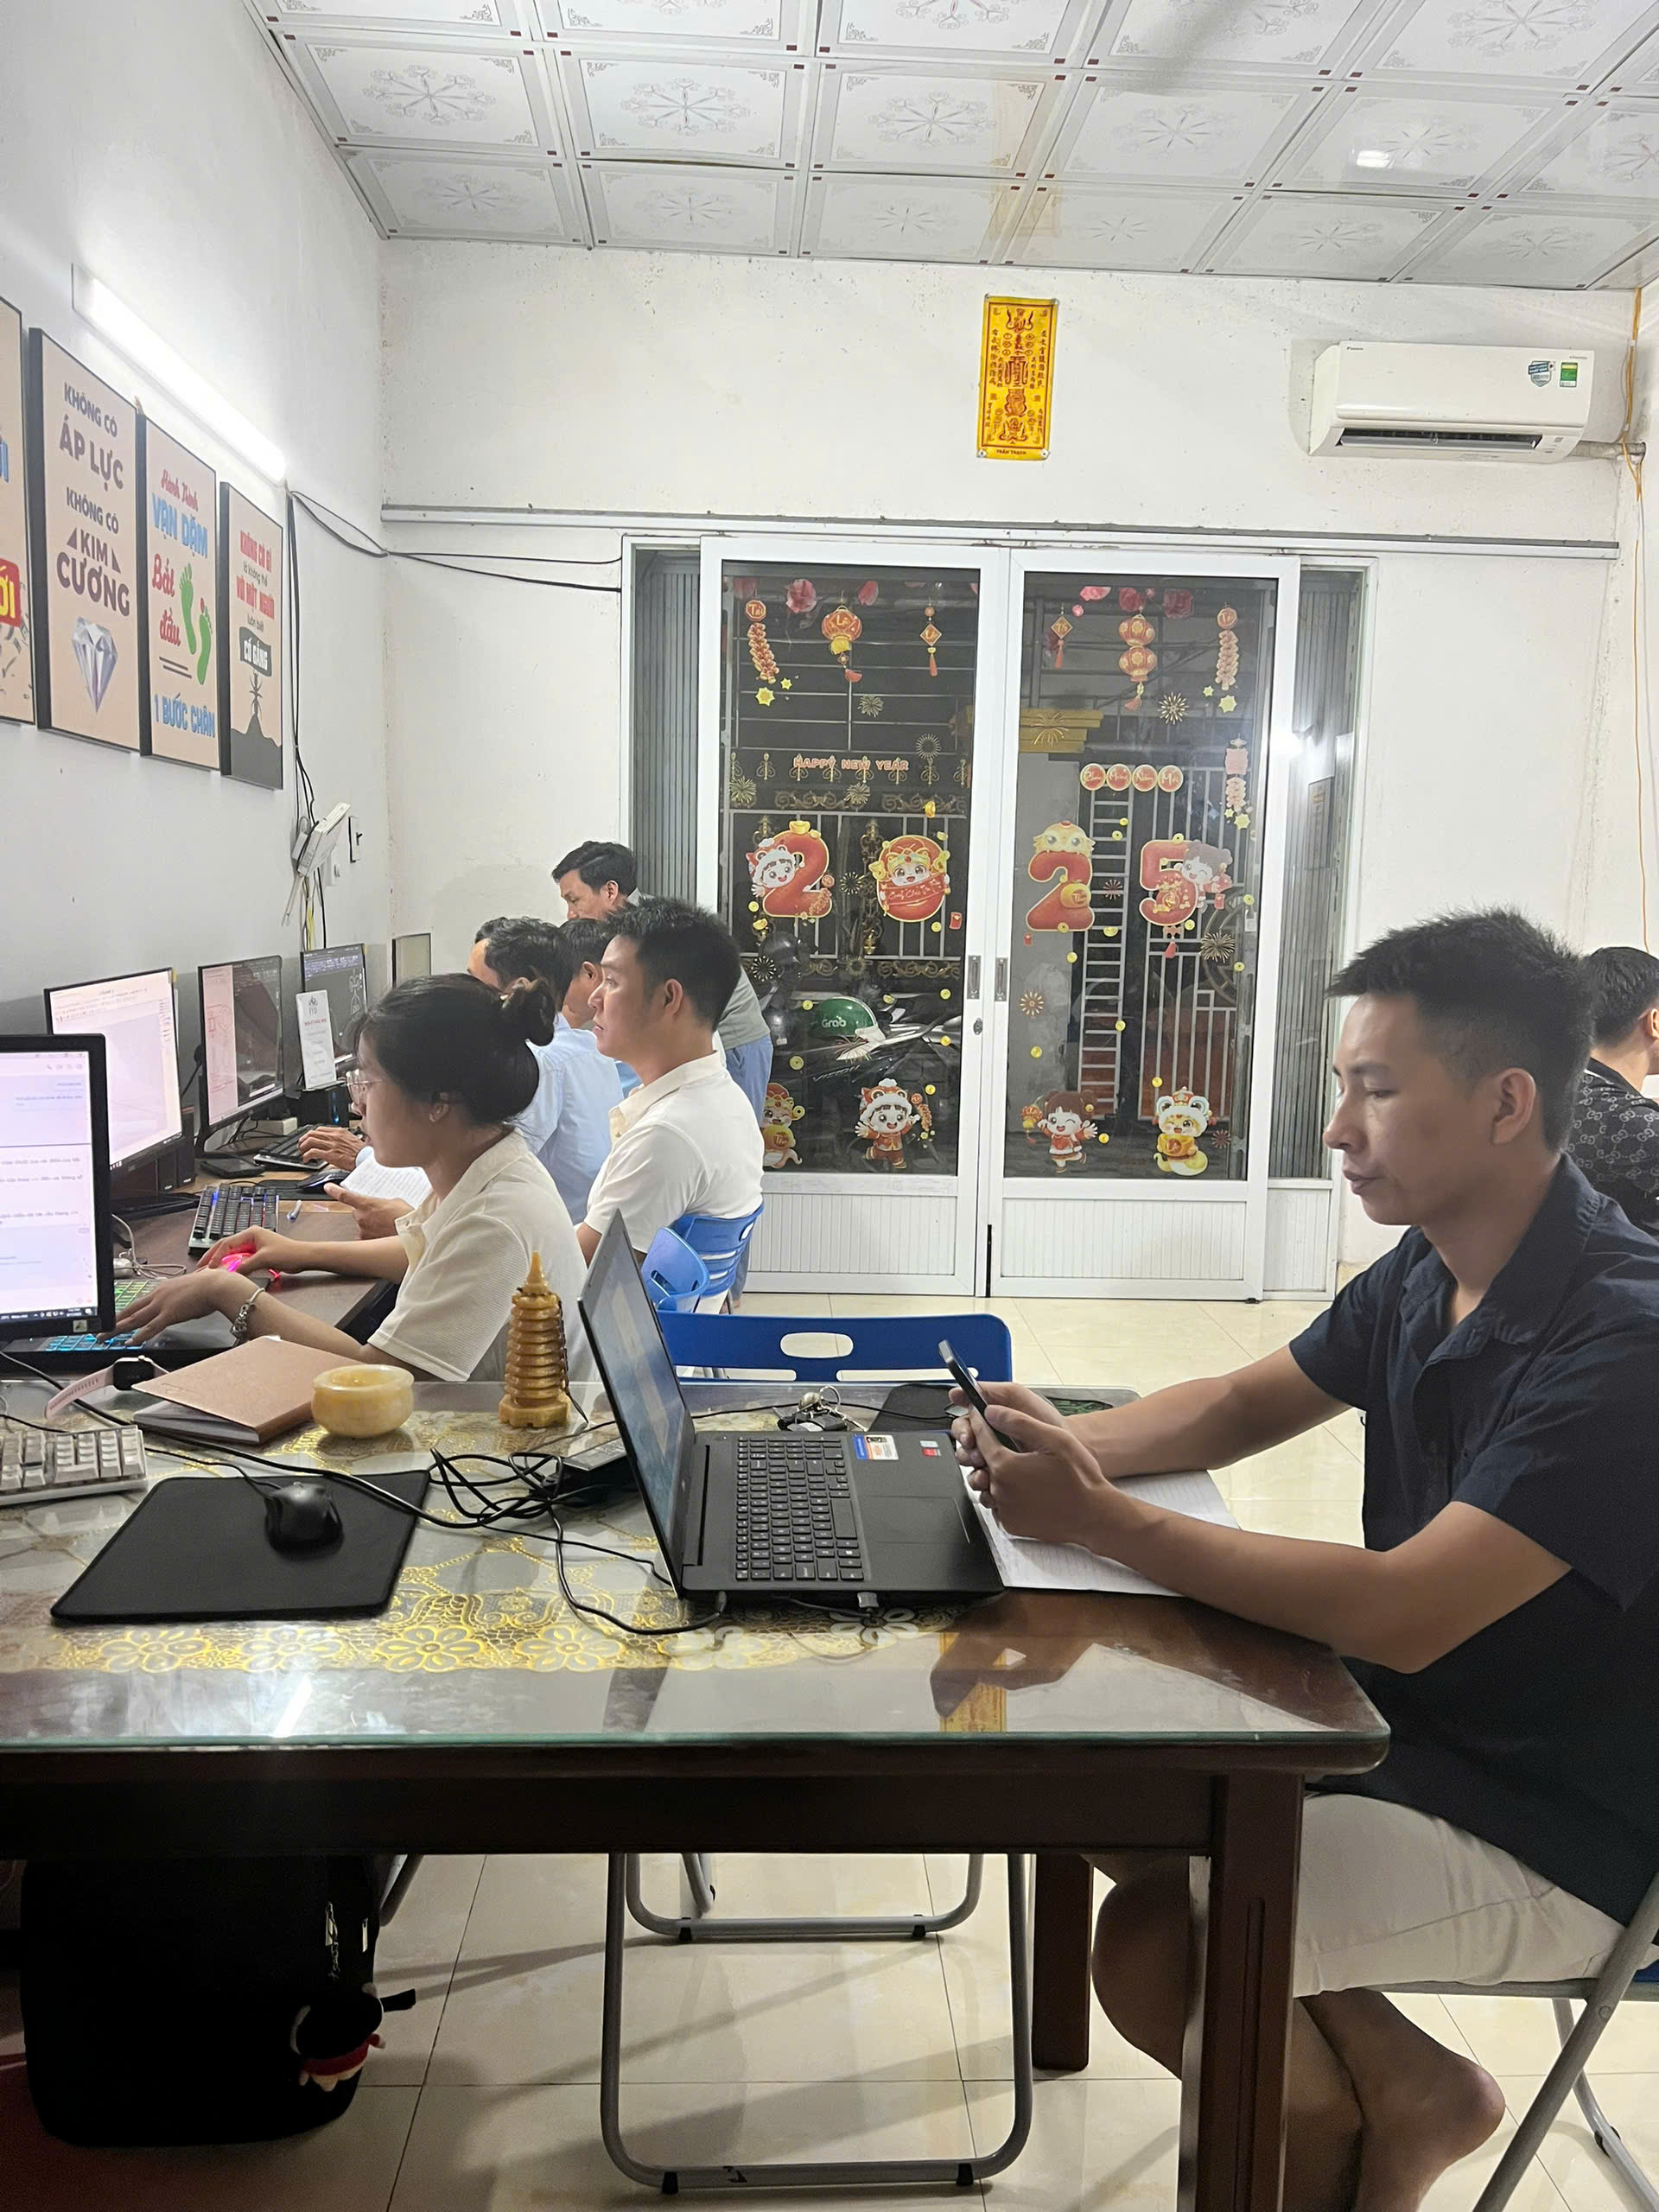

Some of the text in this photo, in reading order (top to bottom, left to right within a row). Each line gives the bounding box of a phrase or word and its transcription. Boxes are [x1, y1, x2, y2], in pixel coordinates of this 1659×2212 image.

[64, 381, 118, 438] KHÔNG CÓ
[60, 414, 86, 461] ÁP
[89, 440, 124, 492] LỰC
[67, 486, 119, 534] KHÔNG CÓ
[152, 492, 208, 559] VẠN DẶM
[80, 528, 108, 568] KIM
[56, 551, 130, 617] CƯƠNG
[154, 692, 216, 738] 1 BƯỚC CHÂN
[793, 756, 909, 772] HAPPY NEW YEAR
[822, 1015, 847, 1028] Grab
